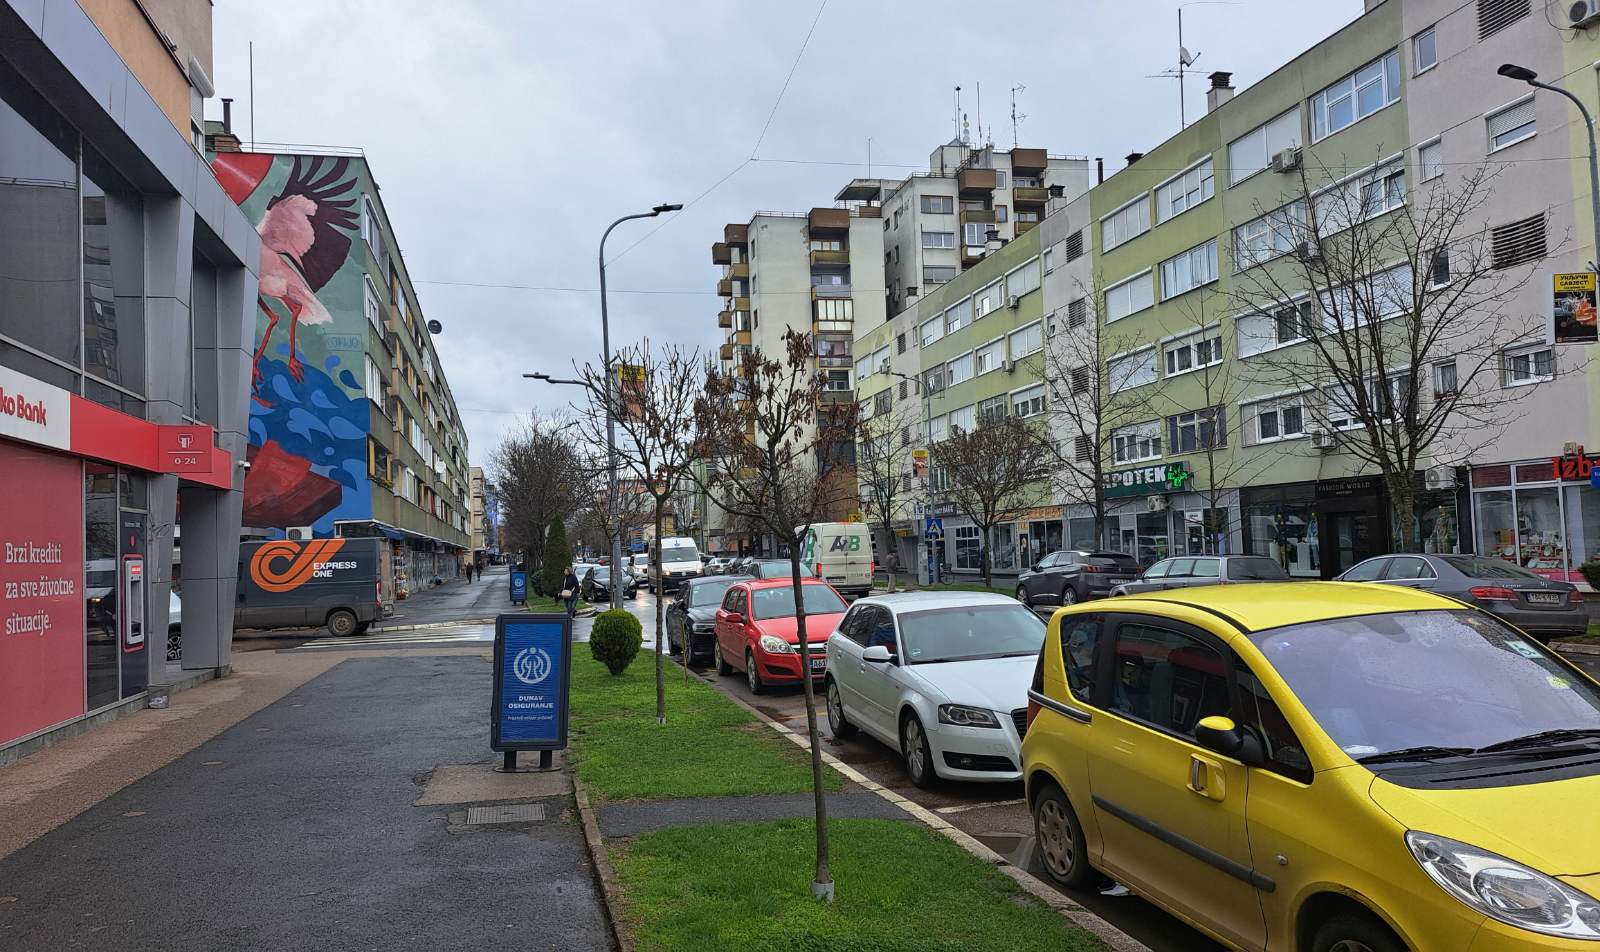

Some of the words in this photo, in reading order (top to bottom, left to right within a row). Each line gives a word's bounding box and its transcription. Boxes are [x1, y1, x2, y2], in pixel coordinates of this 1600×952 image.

[16, 394, 47, 426] Bank
[1551, 445, 1600, 480] Izb
[1102, 465, 1167, 489] APOTEK
[5, 542, 28, 563] Brzi
[29, 541, 62, 564] krediti
[312, 570, 333, 578] ONE
[313, 561, 357, 570] EXPRESS
[5, 582, 18, 598] za
[20, 581, 38, 598] sve
[39, 576, 74, 597] životne
[6, 609, 52, 636] situacije.
